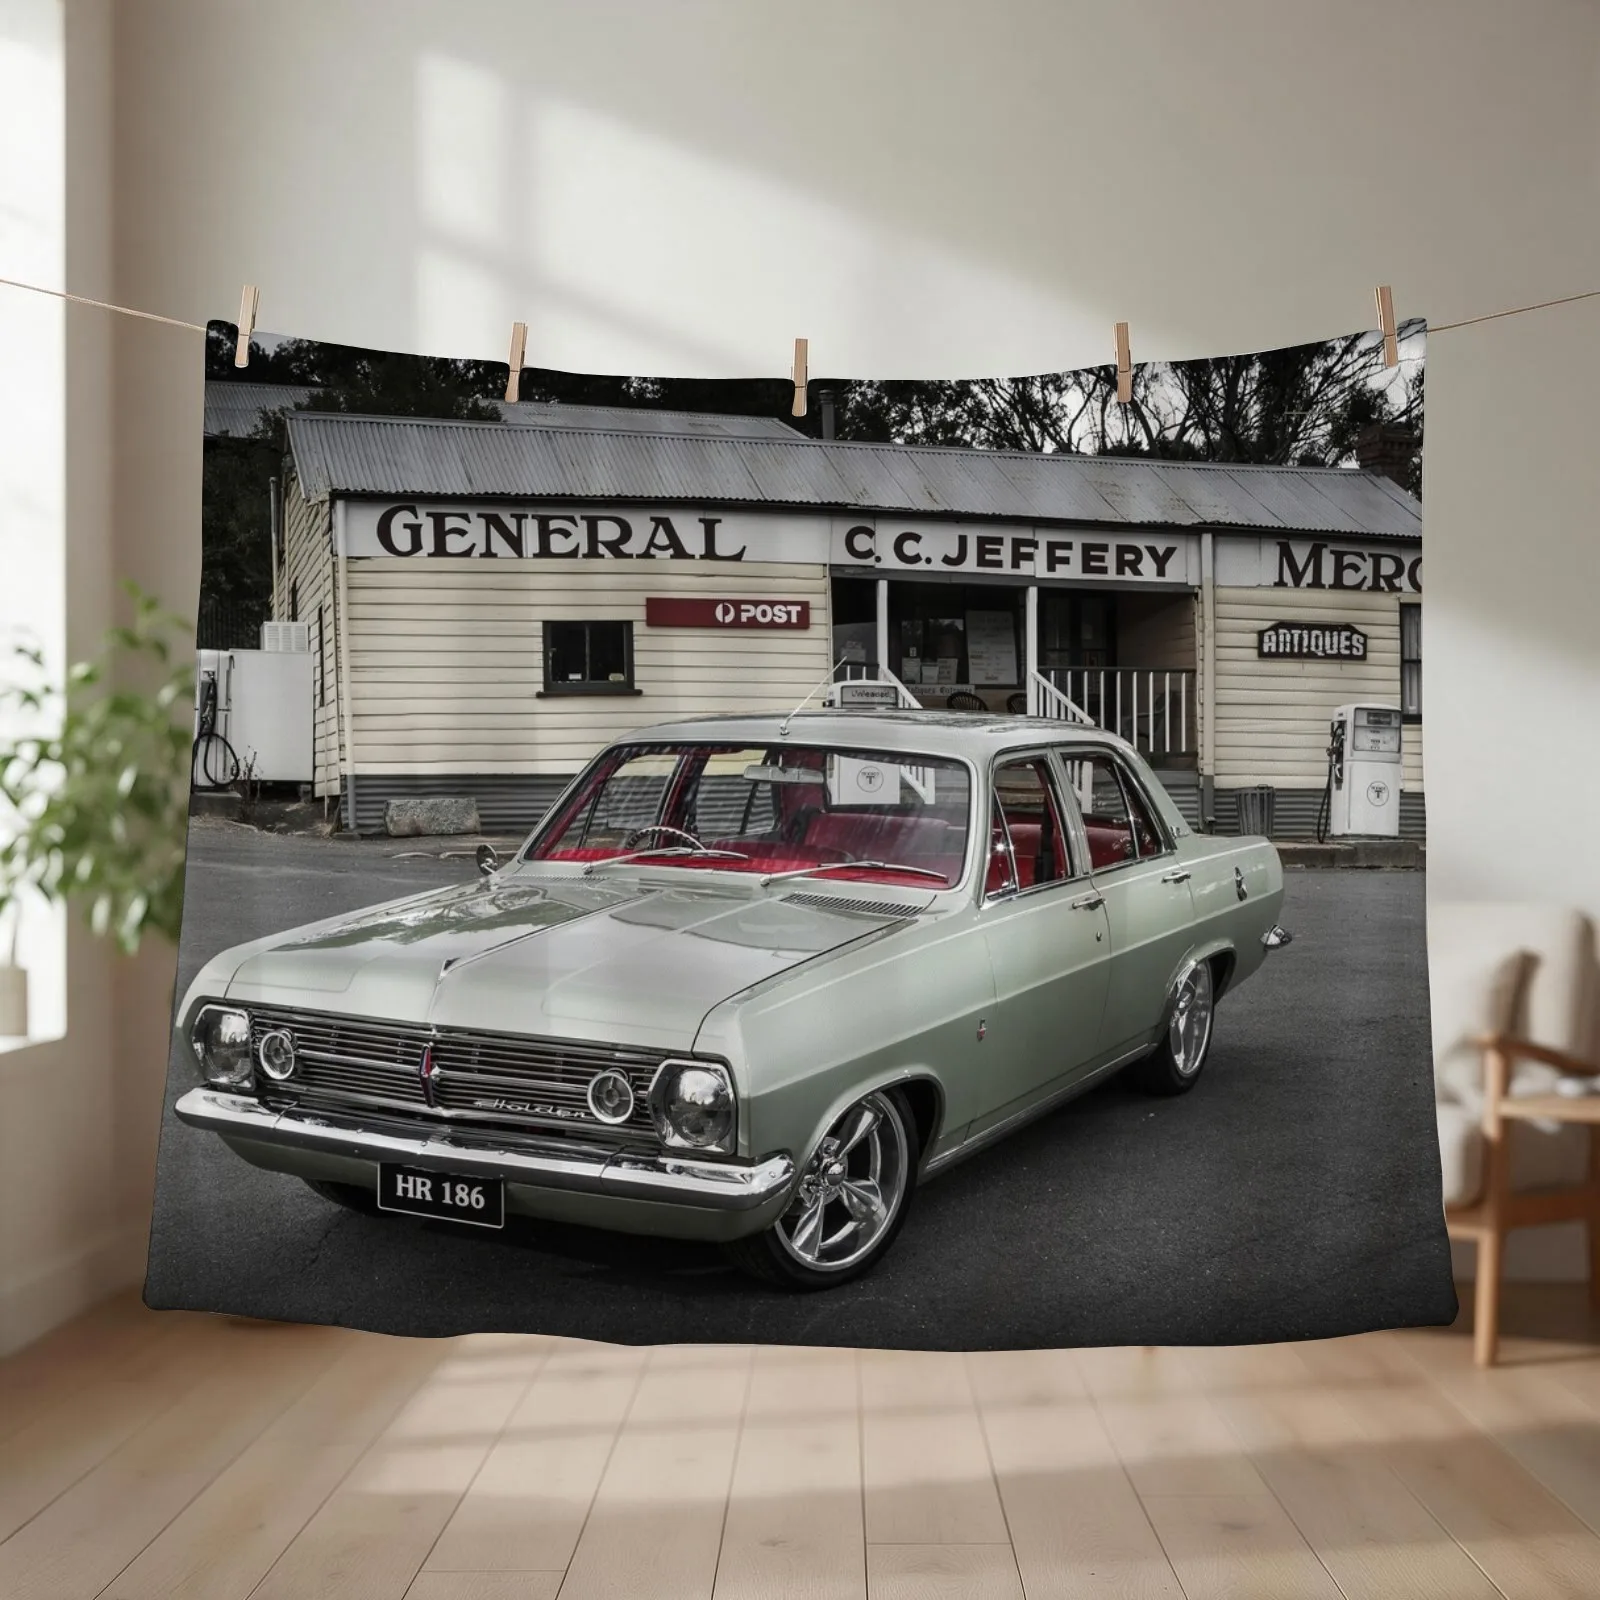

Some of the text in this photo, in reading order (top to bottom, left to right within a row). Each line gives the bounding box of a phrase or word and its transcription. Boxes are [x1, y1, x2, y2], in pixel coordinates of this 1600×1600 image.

[376, 504, 747, 561] GENERAL
[740, 604, 802, 624] POST
[1263, 629, 1364, 656] ANTIQUES
[395, 1174, 485, 1209] HR 186
